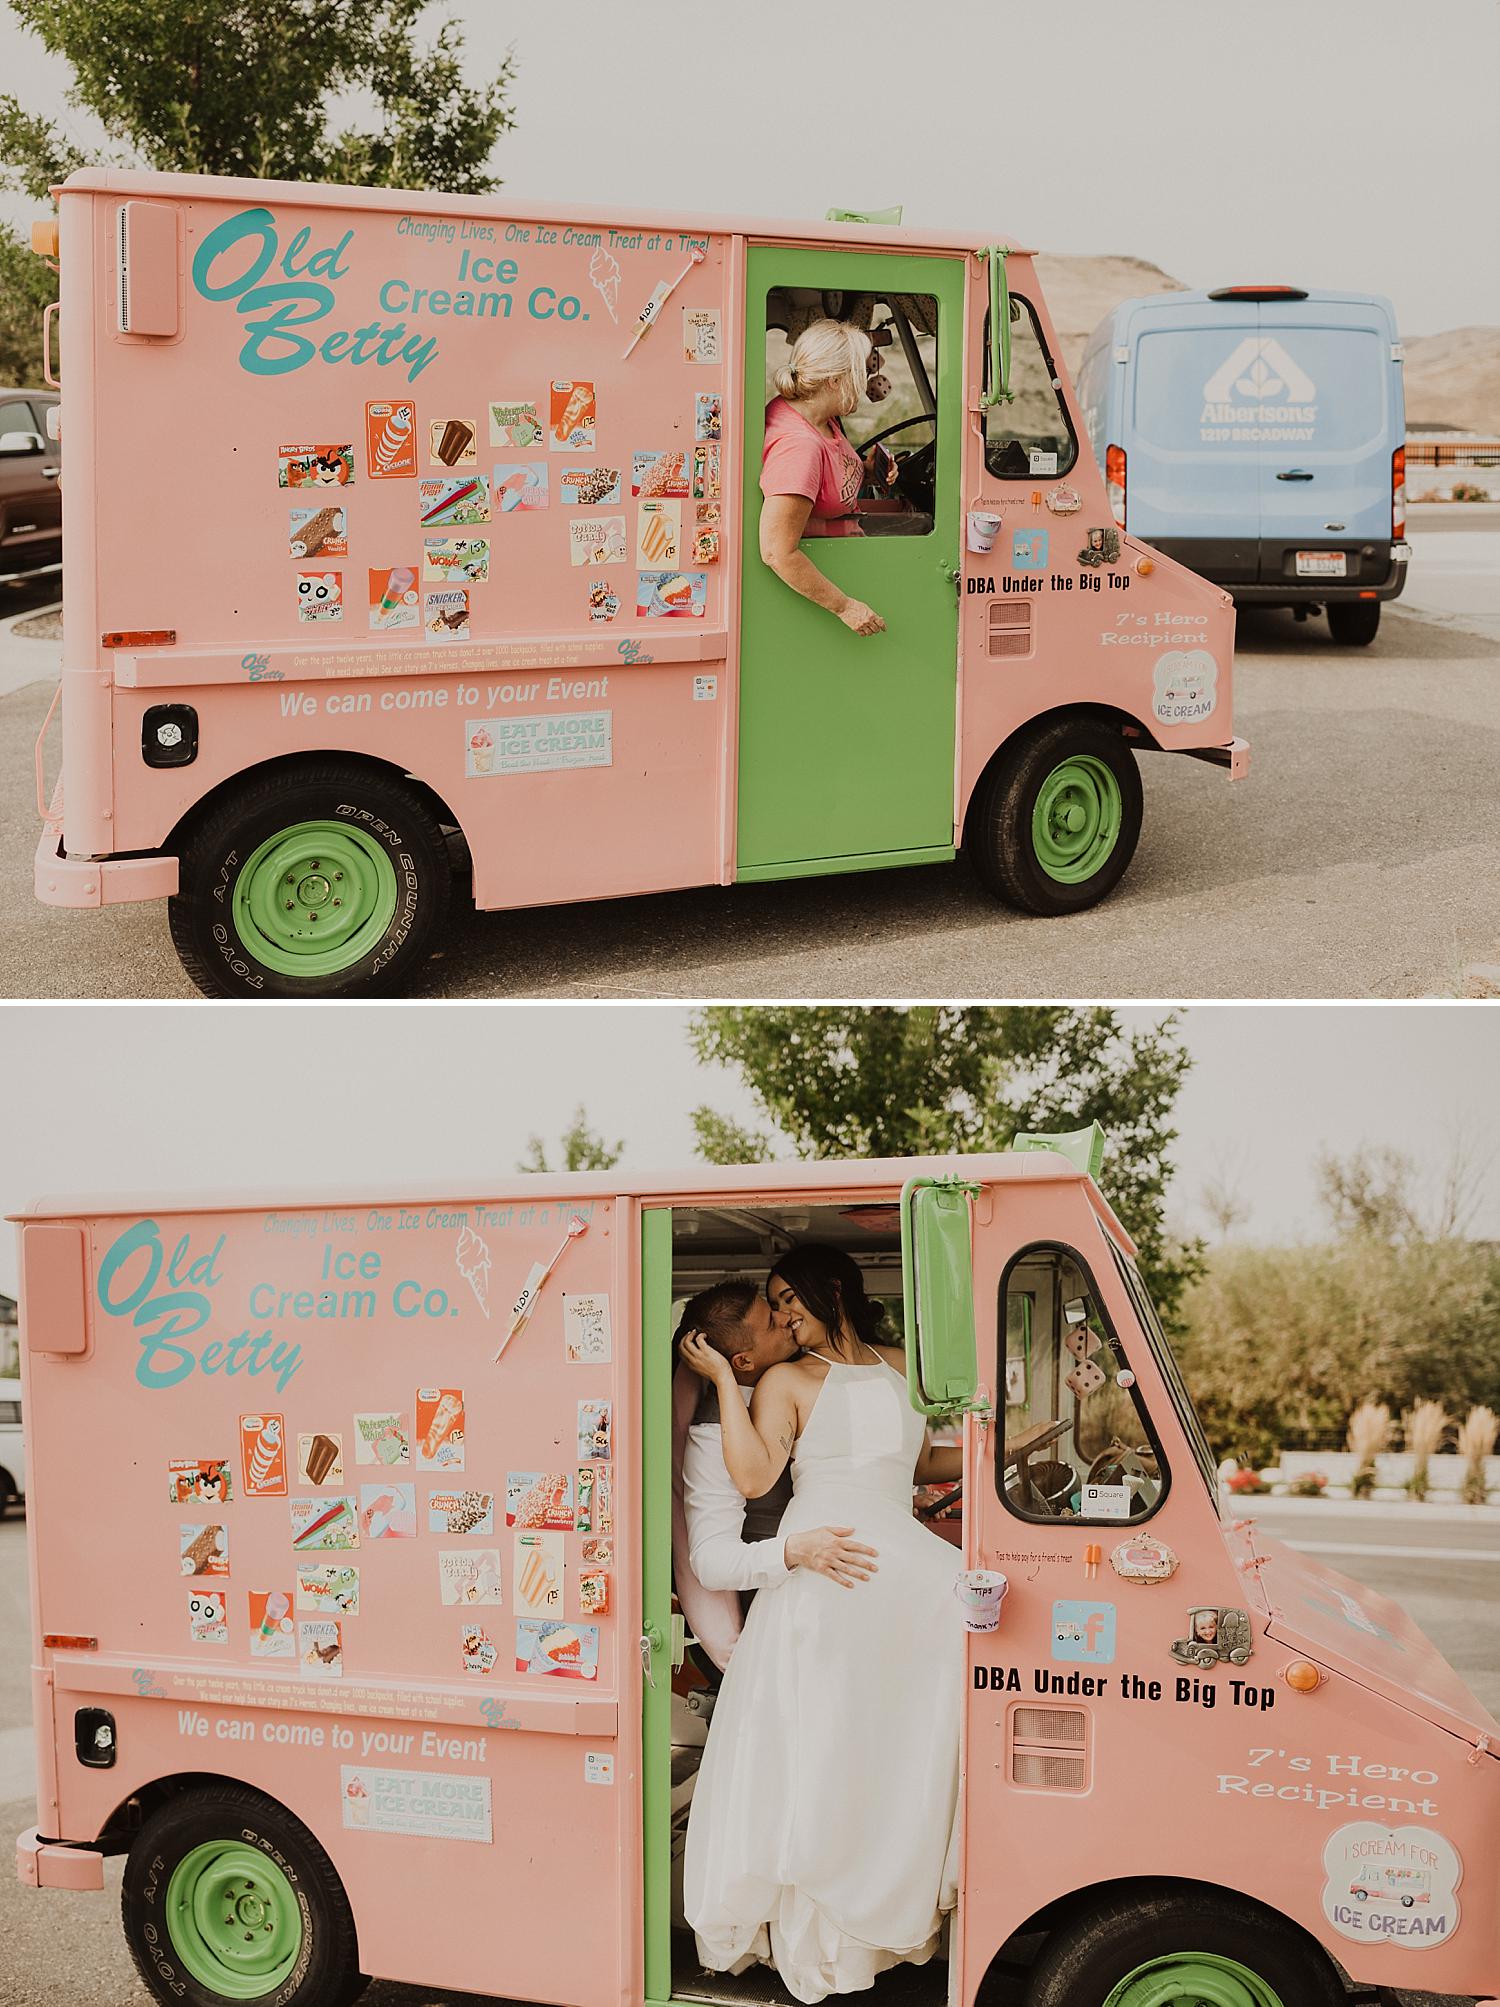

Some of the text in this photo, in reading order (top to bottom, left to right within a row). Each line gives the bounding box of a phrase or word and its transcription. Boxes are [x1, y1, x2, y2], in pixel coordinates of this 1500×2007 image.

[397, 217, 456, 243] Changing
[460, 221, 497, 243] Lives,
[505, 224, 530, 243] One
[535, 226, 557, 244] Ice
[562, 228, 602, 247] Cream
[608, 230, 643, 250] Treat
[647, 234, 661, 250] at
[665, 238, 673, 251] a
[192, 208, 354, 301] Old
[458, 249, 518, 284] Ice
[380, 279, 590, 321] Cream Co.
[237, 281, 439, 384] Betty
[1200, 404, 1316, 423] Albertsons
[1200, 428, 1314, 441] 1219 BROADWAY
[967, 573, 1130, 595] DBA Under the Big Top
[1115, 612, 1209, 626] 7's Hero
[617, 639, 642, 654] Old
[1100, 631, 1209, 648] Recipient
[241, 653, 270, 670] Old
[249, 665, 285, 682] Betty
[294, 656, 307, 666] Over
[310, 656, 321, 665] the
[322, 656, 334, 666] past
[624, 650, 654, 665] Betty
[280, 676, 608, 717] We can come to your Event
[1157, 700, 1211, 717] ICE CREAM
[500, 718, 605, 739] EAT MORE
[500, 734, 605, 756] ICE CREAM
[336, 804, 402, 846] OPEN
[214, 851, 239, 903] A/T
[372, 854, 418, 975] COUNTRY
[212, 924, 264, 989] TOYO
[264, 1213, 318, 1239] Changing
[323, 1212, 358, 1235] Lives,
[367, 1210, 393, 1231] One
[398, 1209, 420, 1229] Ice
[425, 1208, 468, 1228] Cream
[475, 1206, 513, 1227] Treat
[520, 1206, 535, 1225] at
[541, 1210, 549, 1225] a
[97, 1219, 226, 1317] Old
[321, 1244, 382, 1280] Ice
[250, 1281, 458, 1319] Cream Co.
[133, 1291, 304, 1393] Betty
[1099, 1490, 1124, 1499] Square
[996, 1551, 1005, 1561] Tips
[1011, 1552, 1020, 1562] help
[1042, 1553, 1059, 1562] friend's
[971, 1588, 992, 1597] Tips
[974, 1666, 1275, 1711] DBA Under the Big Top
[178, 1710, 487, 1762] We can come to your Event
[1248, 1749, 1439, 1784] 7's Hero
[374, 1776, 483, 1801] EAT MORE
[1217, 1775, 1439, 1816] Recipient
[375, 1795, 484, 1820] ICE CREAM
[241, 1829, 297, 1882] OPEN
[1344, 1840, 1438, 1867] I SCREAM FOR
[143, 1856, 165, 1904] A/T
[1334, 1905, 1446, 1935] ICE CREAM
[144, 1923, 186, 1997] TOYO
